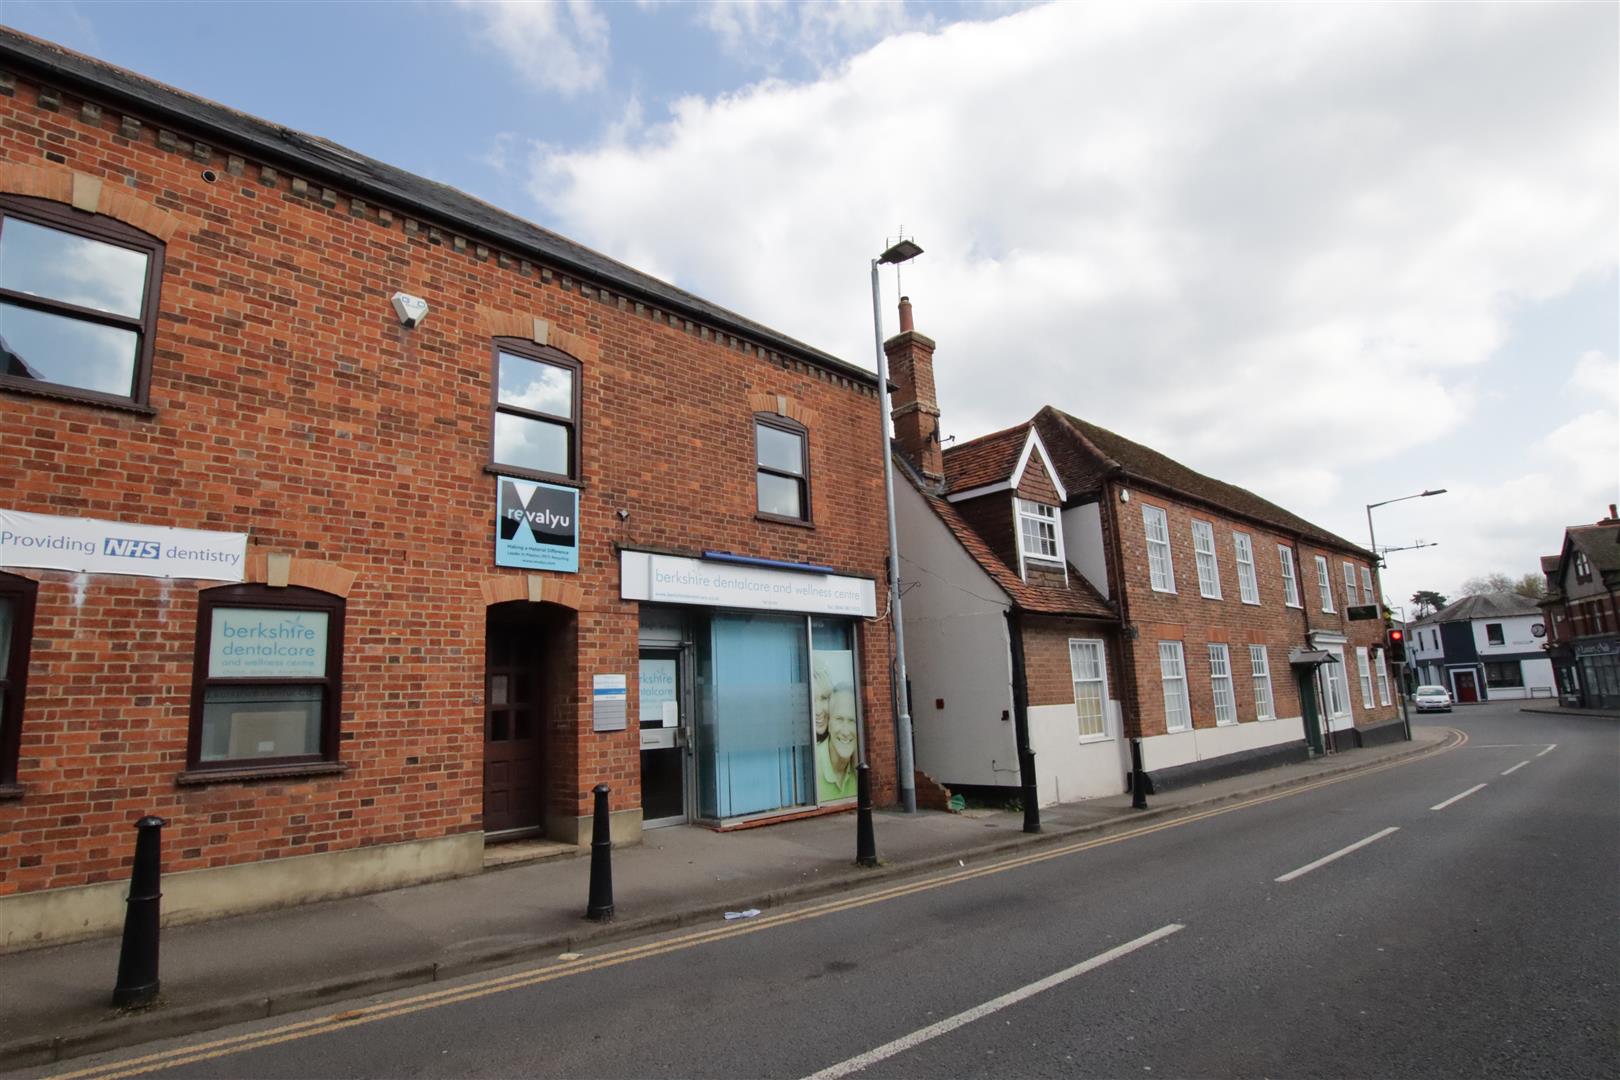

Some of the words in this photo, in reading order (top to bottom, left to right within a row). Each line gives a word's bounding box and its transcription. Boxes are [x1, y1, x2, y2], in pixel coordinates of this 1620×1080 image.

[507, 508, 570, 529] revalyu
[1, 531, 96, 556] Providing
[104, 538, 160, 559] NHS
[166, 546, 241, 566] dentistry
[655, 568, 710, 587] berkshire
[713, 575, 770, 592] dentalcare
[772, 583, 792, 594] and
[795, 584, 832, 598] wellness
[834, 590, 861, 600] centre
[223, 620, 316, 640] berkshire
[222, 641, 316, 657] dentalcare
[221, 657, 241, 666] and
[640, 671, 673, 685] rkshire
